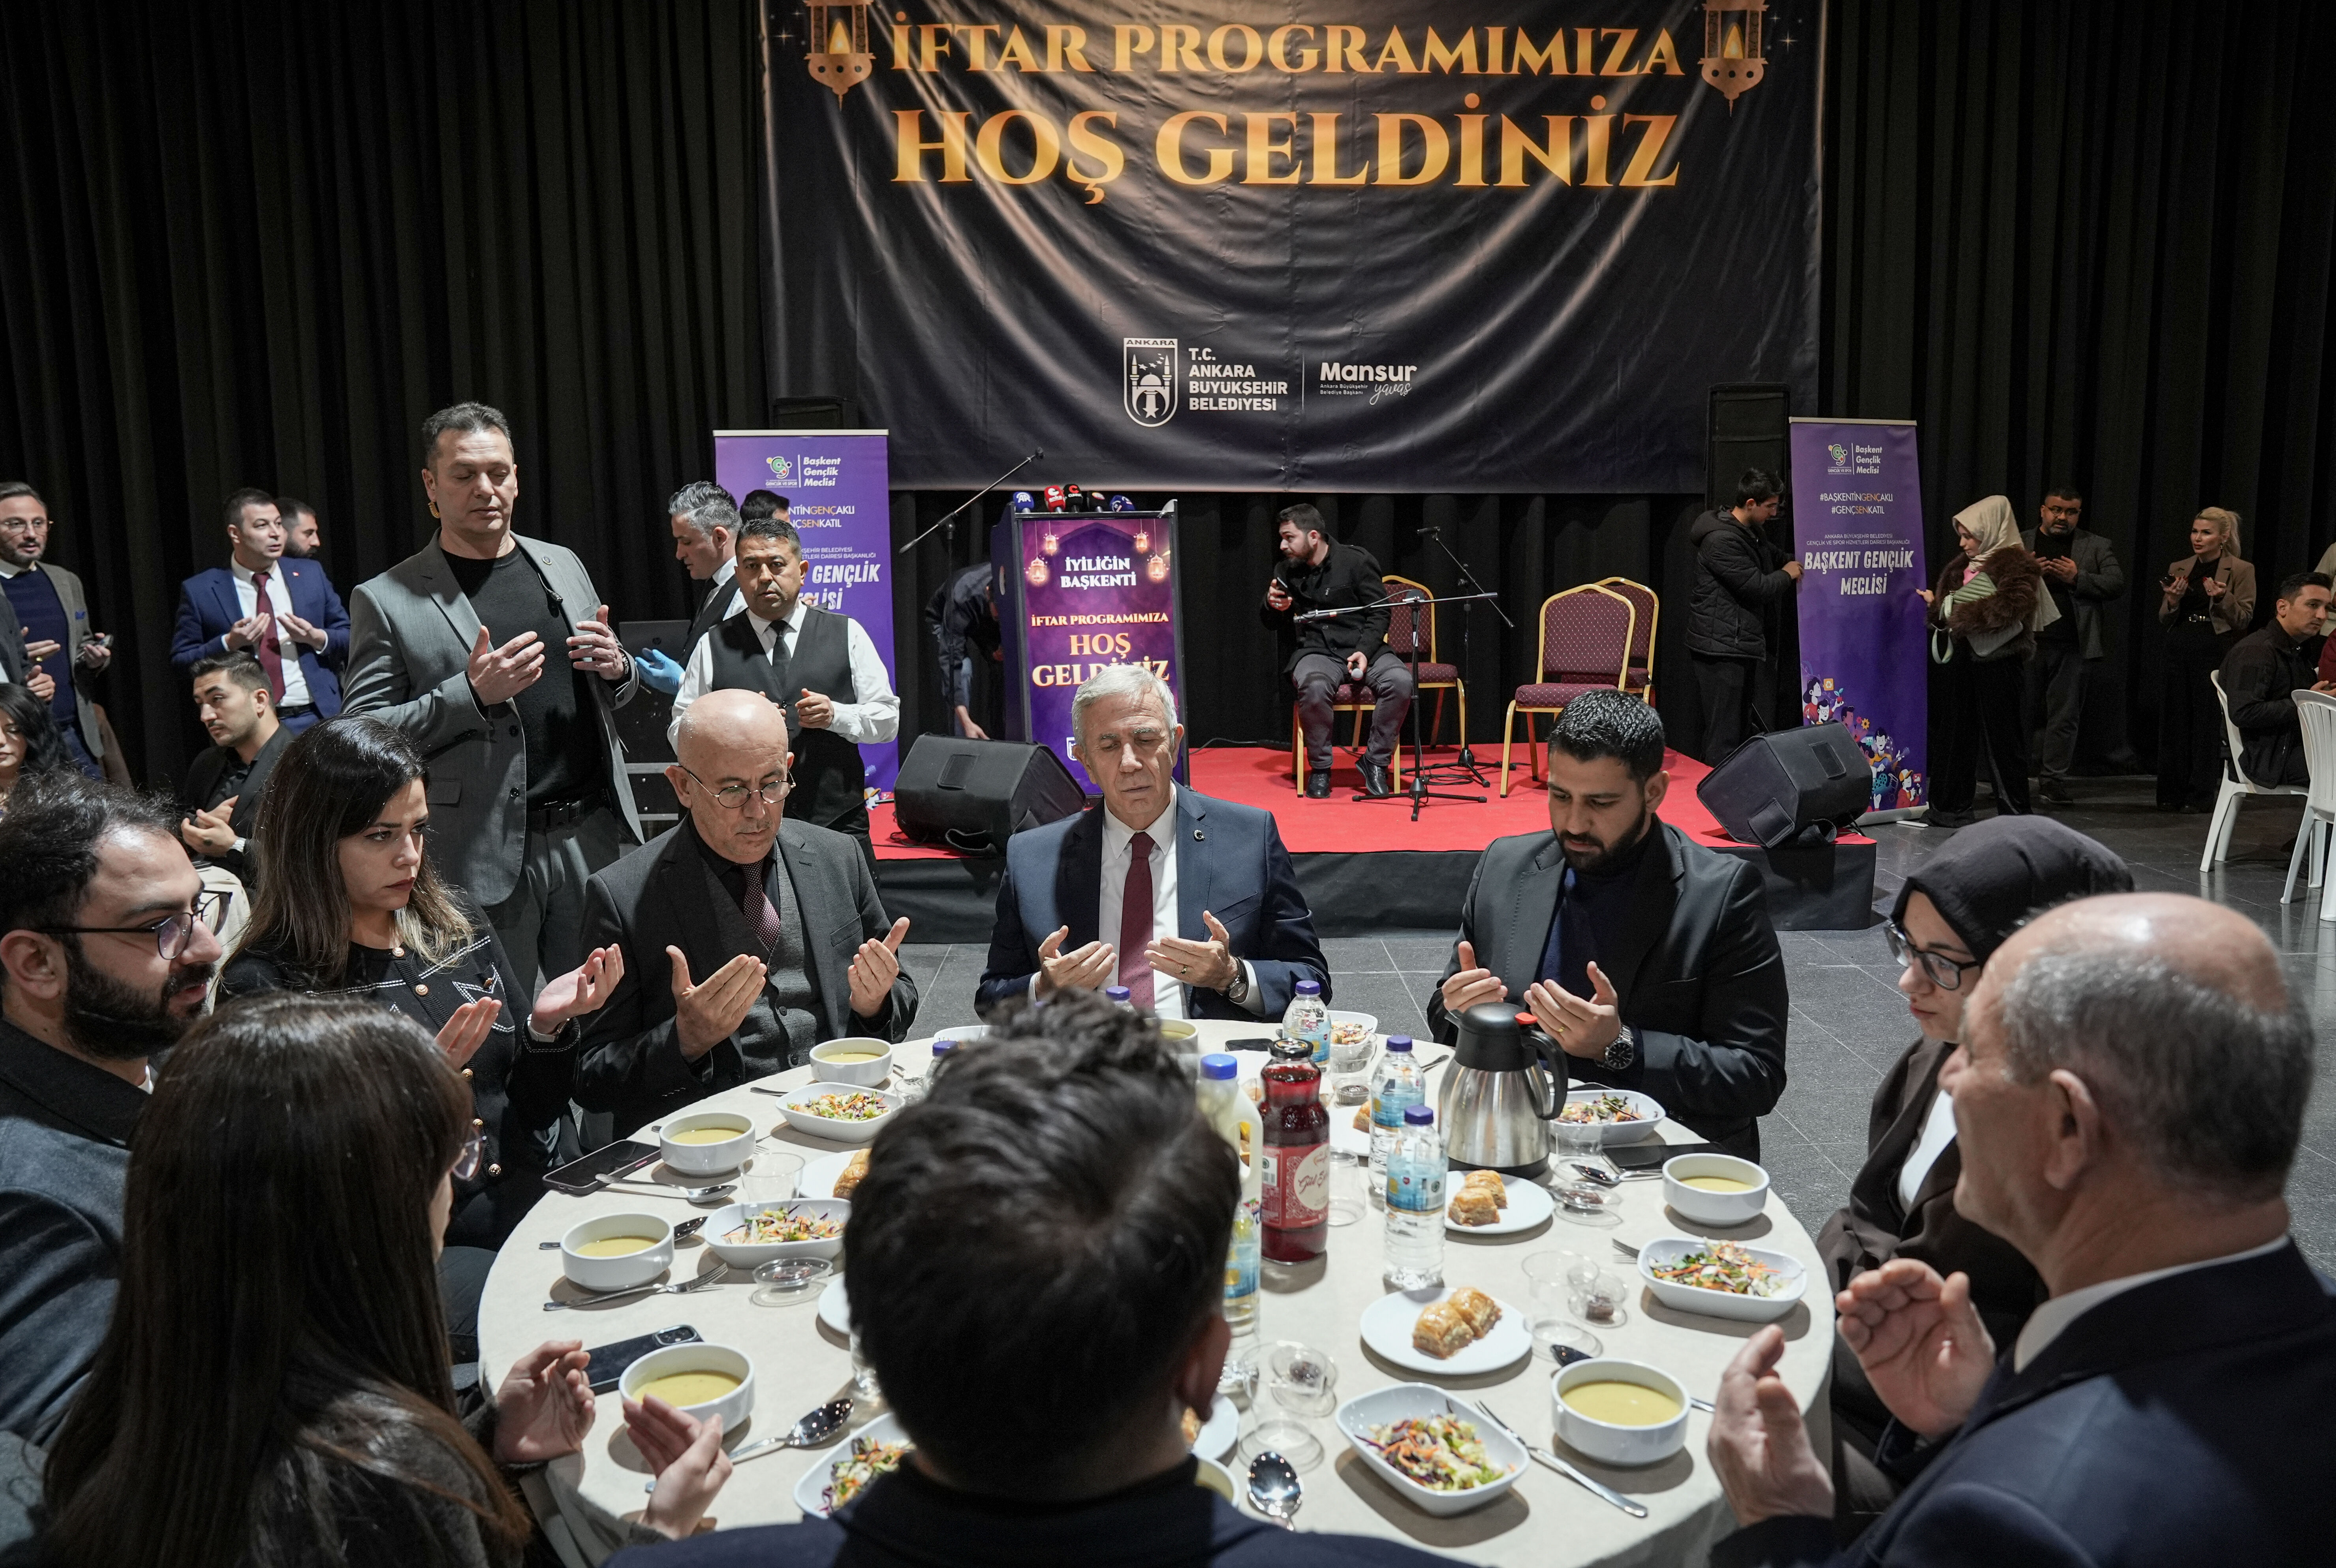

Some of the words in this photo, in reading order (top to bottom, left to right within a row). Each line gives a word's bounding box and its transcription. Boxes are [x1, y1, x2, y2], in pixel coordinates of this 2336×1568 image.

[891, 11, 1096, 72] İFTAR
[1112, 24, 1685, 76] PROGRAMIMIZA
[891, 109, 1124, 204] HOŞ
[1156, 93, 1680, 187] GELDİNİZ
[1188, 348, 1216, 361] T.C.
[1189, 364, 1256, 377] ANKARA
[1320, 362, 1418, 382] Mansur
[1189, 381, 1288, 396] BÜYÜKŞEHİR
[1369, 383, 1412, 406] yavaş
[1189, 397, 1277, 411] BELEDİYESİ
[1855, 445, 1883, 455] Başkent
[803, 456, 841, 467] Başkent
[1856, 455, 1881, 465] Gençlik
[804, 467, 839, 477] Gençlik
[1856, 465, 1879, 474] Meclisi
[804, 477, 836, 486] Meclisi
[1831, 506, 1885, 515] #GENÇSENKATIL
[1065, 556, 1131, 572] İYİLİĞİN
[1804, 551, 1861, 575] BAŞKENT
[1863, 547, 1914, 573] GENÇLİK
[812, 561, 881, 588] GENÇLİK
[1060, 571, 1137, 590] BAŞKENTİ
[1840, 573, 1887, 595] MECLİSİ
[1031, 614, 1068, 627] İFTAR
[1070, 612, 1169, 625] PROGRAMIMIZA
[1069, 633, 1132, 659] HOŞ
